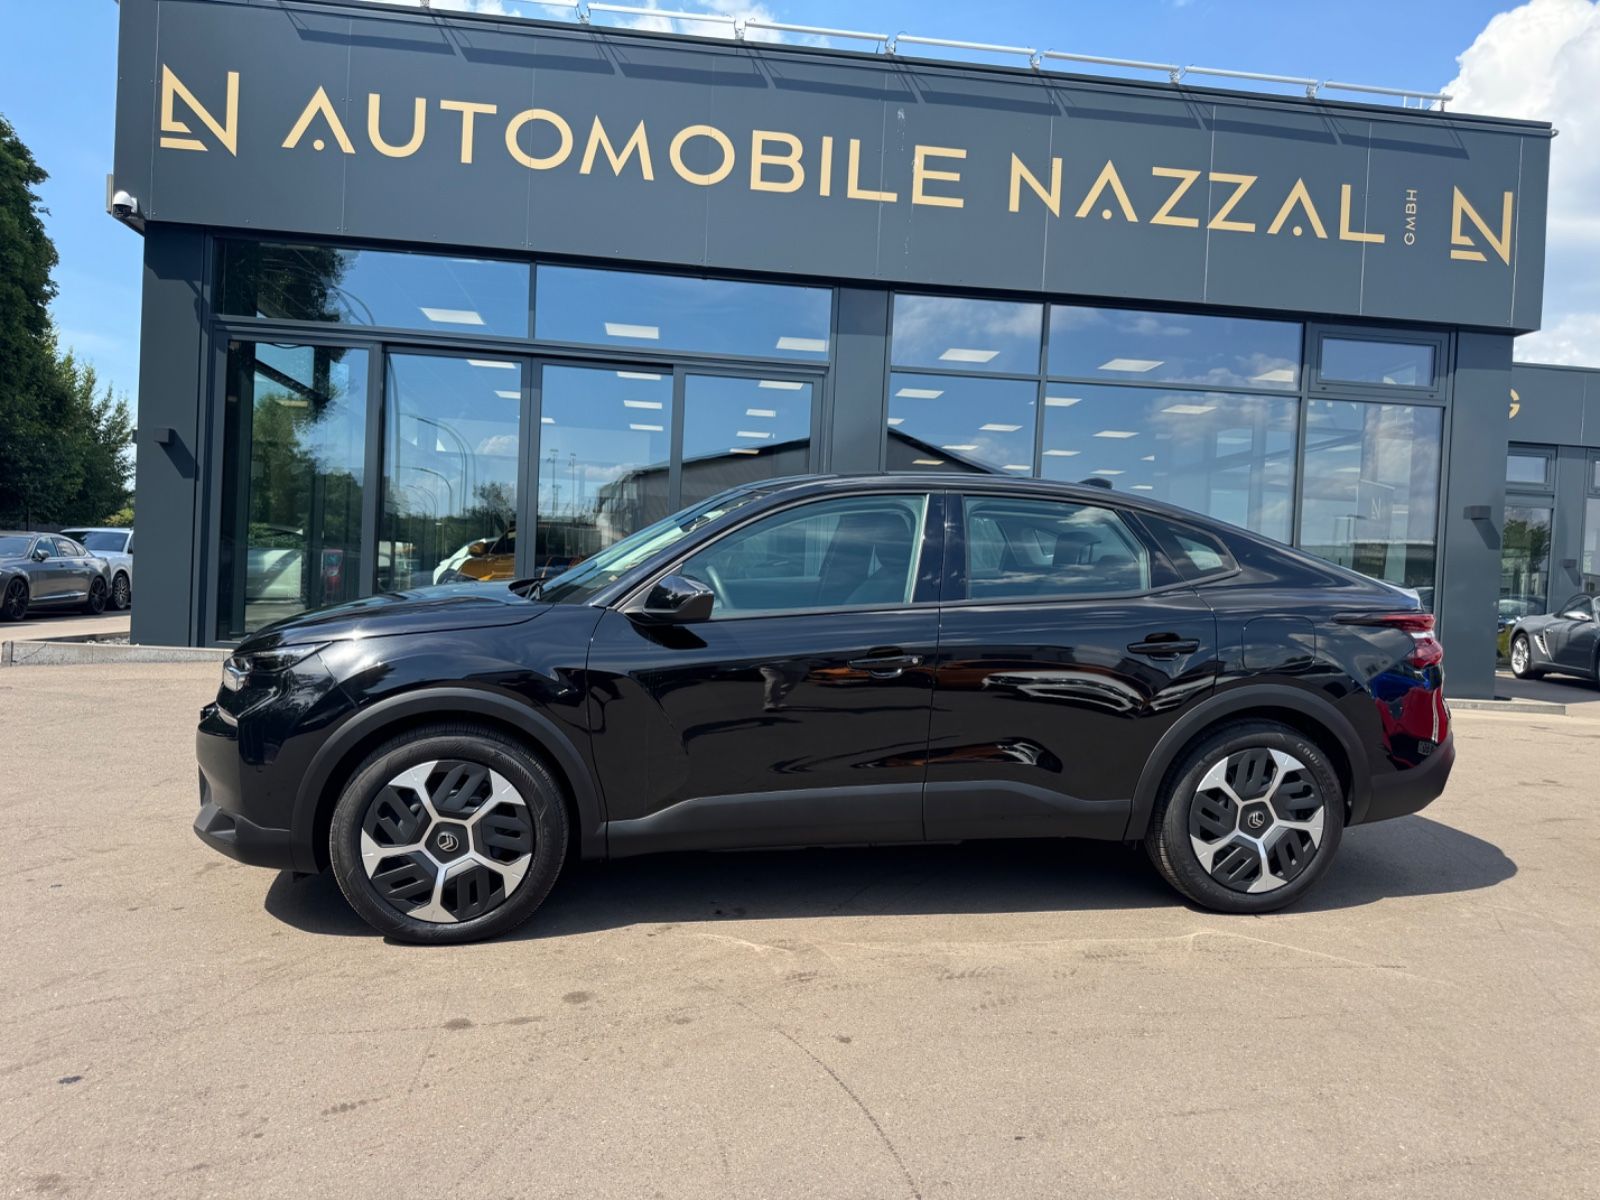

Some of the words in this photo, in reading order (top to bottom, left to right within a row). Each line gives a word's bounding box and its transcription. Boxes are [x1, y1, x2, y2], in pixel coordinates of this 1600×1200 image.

[282, 86, 967, 209] AUTOMOBILE
[1008, 152, 1386, 244] NAZZAL
[1404, 189, 1417, 245] GMBH
